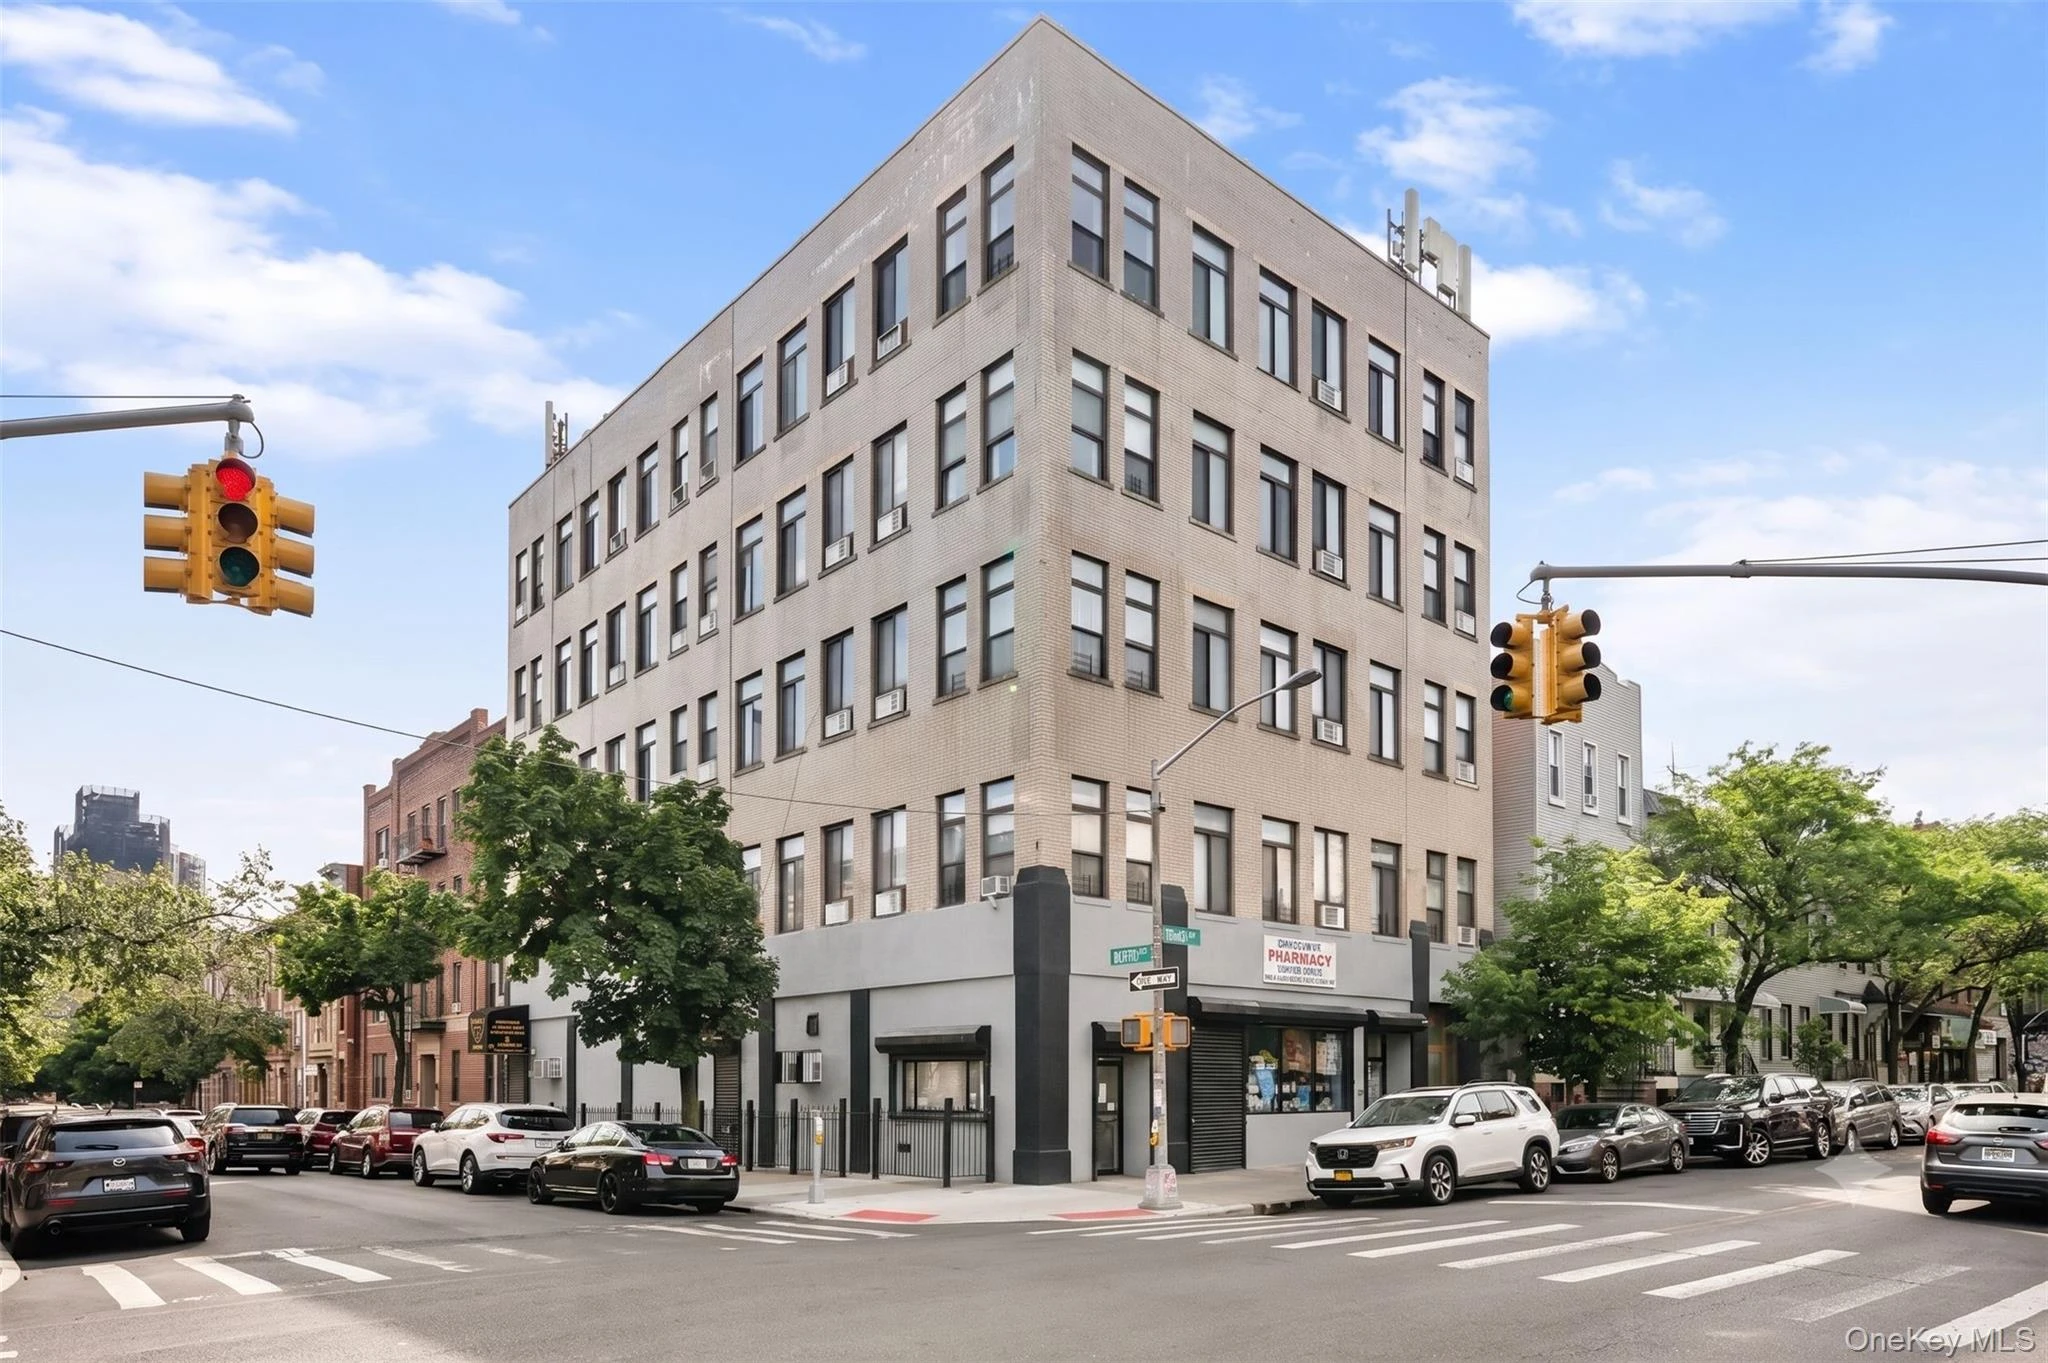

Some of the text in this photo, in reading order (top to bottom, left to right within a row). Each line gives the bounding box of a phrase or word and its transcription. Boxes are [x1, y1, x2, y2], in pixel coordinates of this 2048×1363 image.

[1268, 949, 1332, 967] PHARMACY
[1136, 974, 1172, 986] ONE WAY
